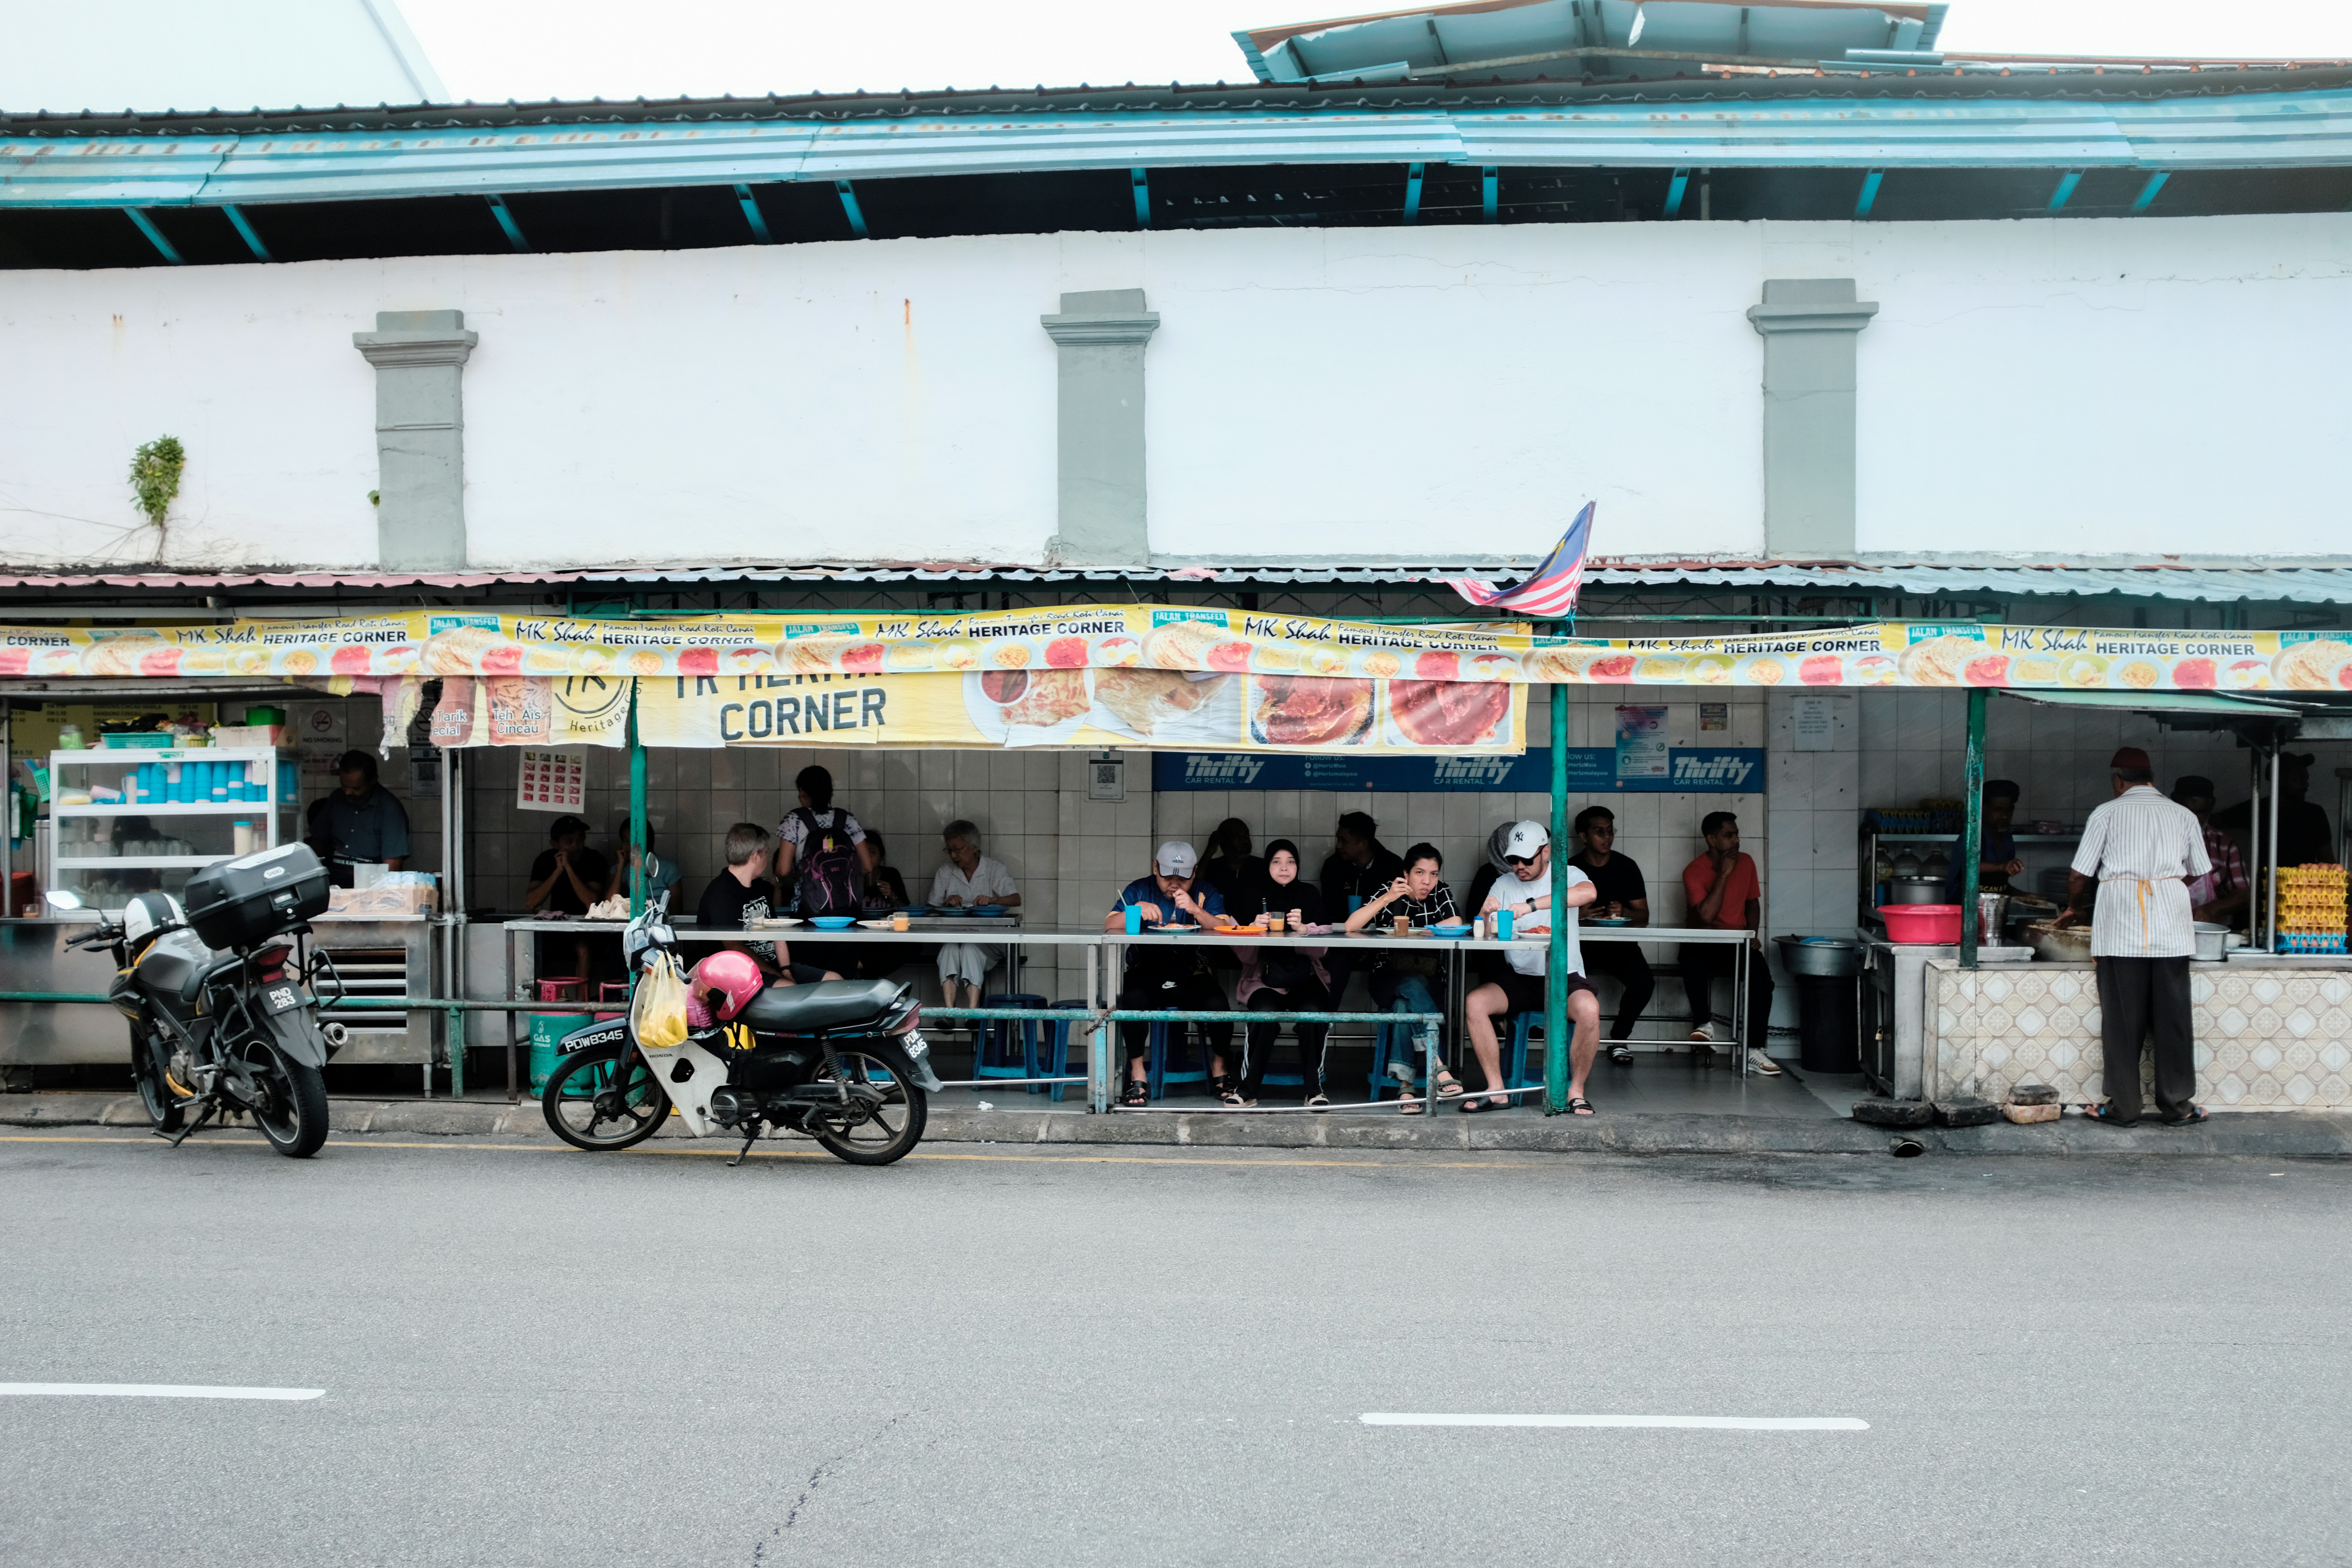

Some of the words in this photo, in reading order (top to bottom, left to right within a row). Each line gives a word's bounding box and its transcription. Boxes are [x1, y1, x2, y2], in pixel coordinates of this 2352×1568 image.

[433, 619, 457, 628] JALAN
[459, 617, 497, 626] TRANSFER
[1156, 612, 1181, 621] JALAN
[1185, 612, 1225, 621] TRANSFER
[298, 621, 332, 632] Transfer
[335, 619, 356, 628] Road
[359, 619, 377, 627] Roti
[380, 618, 406, 627] Canai
[516, 620, 547, 640] MK
[554, 621, 597, 641] Shah
[603, 622, 637, 631] Famous
[639, 623, 675, 635] Transfer
[679, 624, 701, 632] Road
[704, 624, 723, 632] Roti
[726, 624, 754, 633] Canai
[789, 626, 813, 634] JALAN
[876, 622, 909, 638] MK
[916, 619, 962, 638] Shah
[969, 624, 1051, 637] HERITAGE
[1057, 621, 1124, 633] CORNER
[1245, 617, 1279, 637] MK
[1285, 620, 1331, 641] Shah
[1338, 623, 1374, 634] Famous
[1377, 626, 1414, 639] Transfer
[1419, 630, 1442, 639] Road
[1911, 627, 1937, 637] JALAN
[1942, 626, 1982, 635] TRANSFER
[7, 636, 69, 646] CORNER
[176, 628, 208, 643] MK
[214, 626, 256, 644] Shah
[263, 633, 338, 644] HERITAGE
[343, 631, 407, 642] CORNER
[603, 633, 682, 644] HERITAGE
[1339, 633, 1423, 648] HERITAGE
[1429, 641, 1499, 650] CORNER
[2002, 628, 2034, 649] MK
[2042, 629, 2087, 651] Shah
[2094, 629, 2129, 638] Famous
[2132, 630, 2170, 642] Transfer
[2283, 633, 2309, 641] JALAN
[1628, 640, 1661, 650] MK
[1668, 639, 1715, 651] Shah
[1724, 642, 1807, 653] HERITAGE
[1812, 641, 1880, 652] CORNER
[2096, 642, 2180, 654] HERITAGE
[2185, 644, 2255, 655] CORNER
[437, 709, 467, 722] Tarik
[494, 710, 513, 720] Teh
[522, 710, 541, 720] Ais
[570, 706, 628, 732] Heritage
[720, 687, 887, 741] CORNER
[431, 723, 460, 735] ecial
[498, 722, 539, 733] Cincau
[1185, 755, 1265, 783] Thrifty
[1434, 757, 1514, 784] Thrifty
[1674, 757, 1754, 784] Thrifty
[267, 868, 283, 877] SHOEI
[269, 987, 292, 1001] PND
[274, 995, 296, 1009] 283
[534, 1034, 551, 1043] GAS
[565, 1029, 623, 1052] PDW8345
[904, 1029, 920, 1047] PDW
[908, 1038, 927, 1058] 8345
